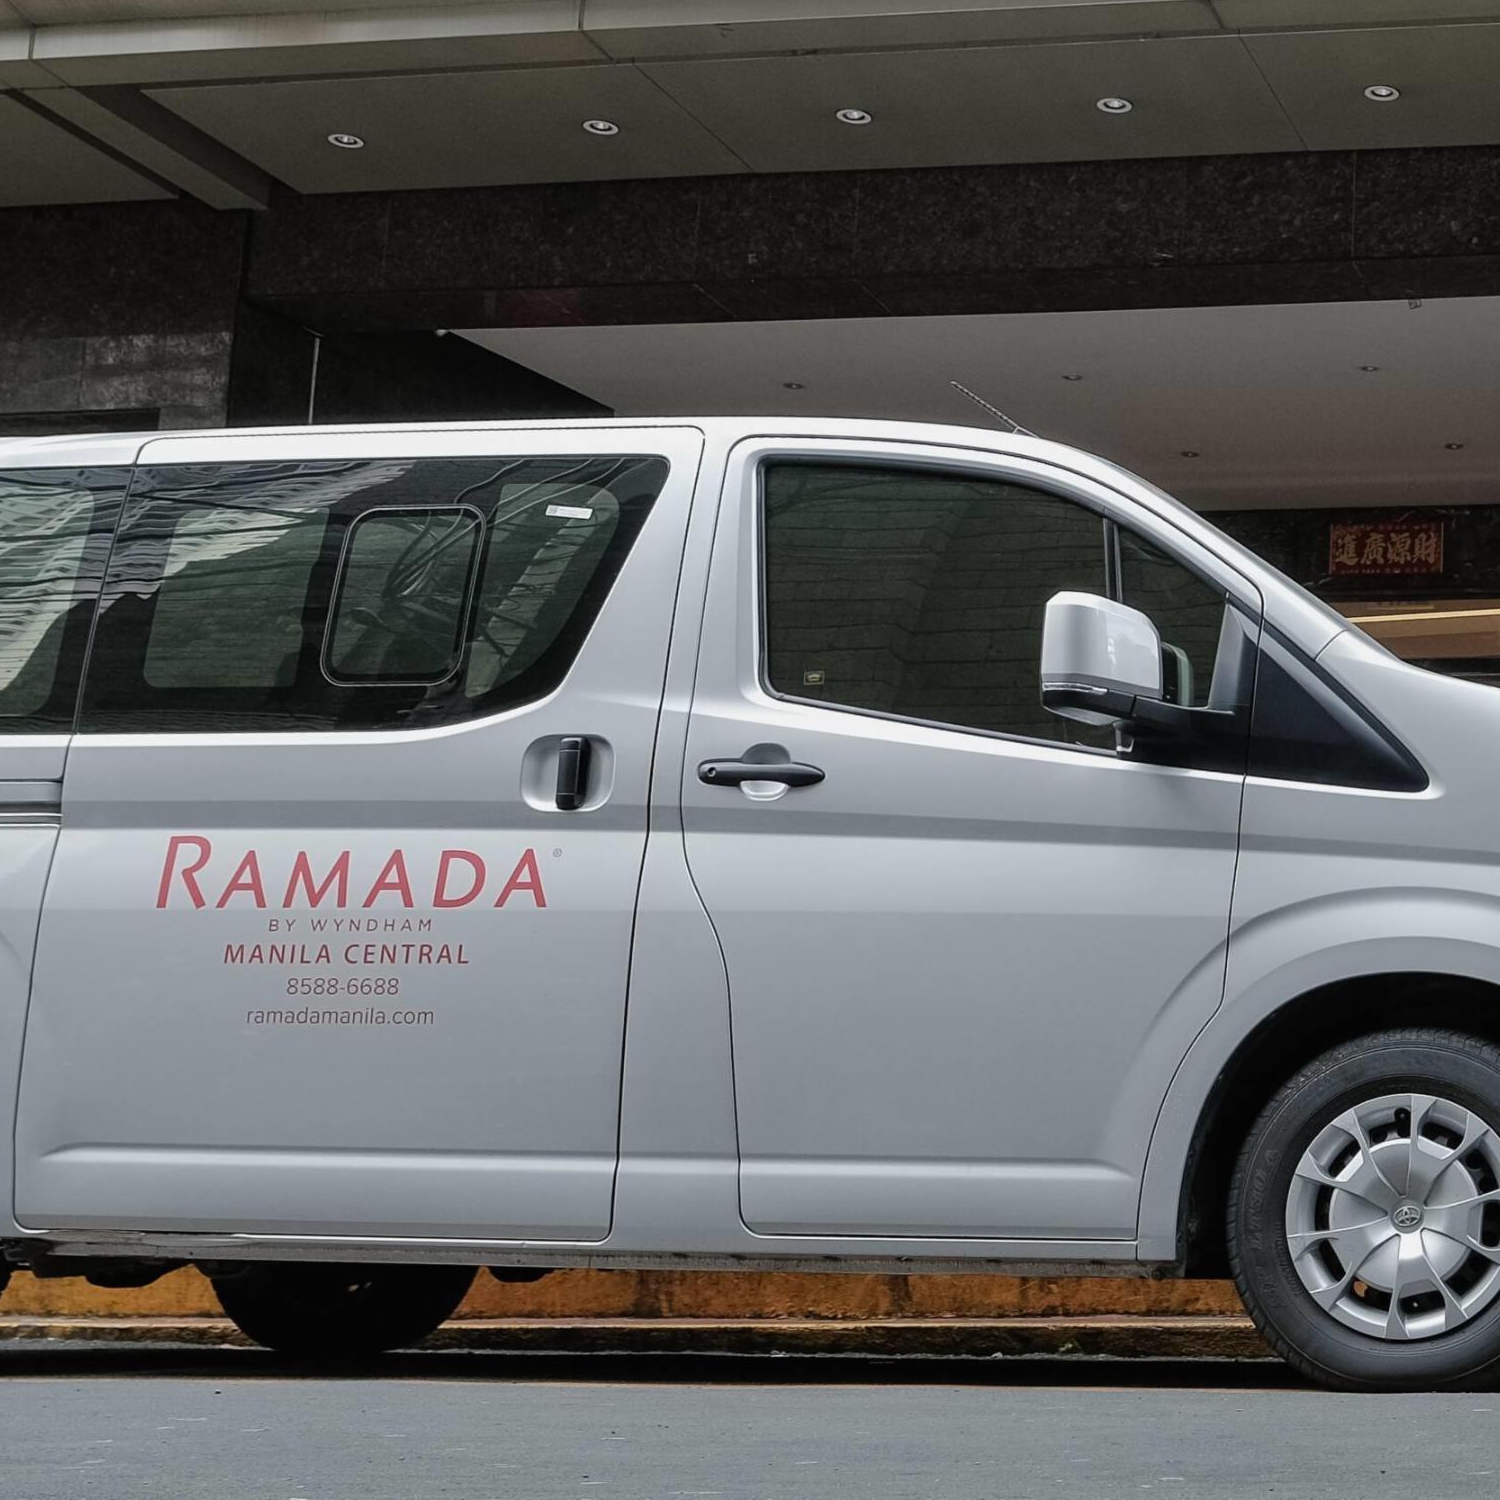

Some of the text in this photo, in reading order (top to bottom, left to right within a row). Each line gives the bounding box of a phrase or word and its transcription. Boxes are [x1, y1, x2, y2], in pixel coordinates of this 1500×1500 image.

[156, 834, 548, 910] RAMADA
[268, 918, 433, 933] BY WYNDHAM
[223, 943, 470, 965] MANILA CENTRAL
[286, 977, 399, 997] 8588-6688
[245, 1006, 435, 1026] ramadamanila.com
